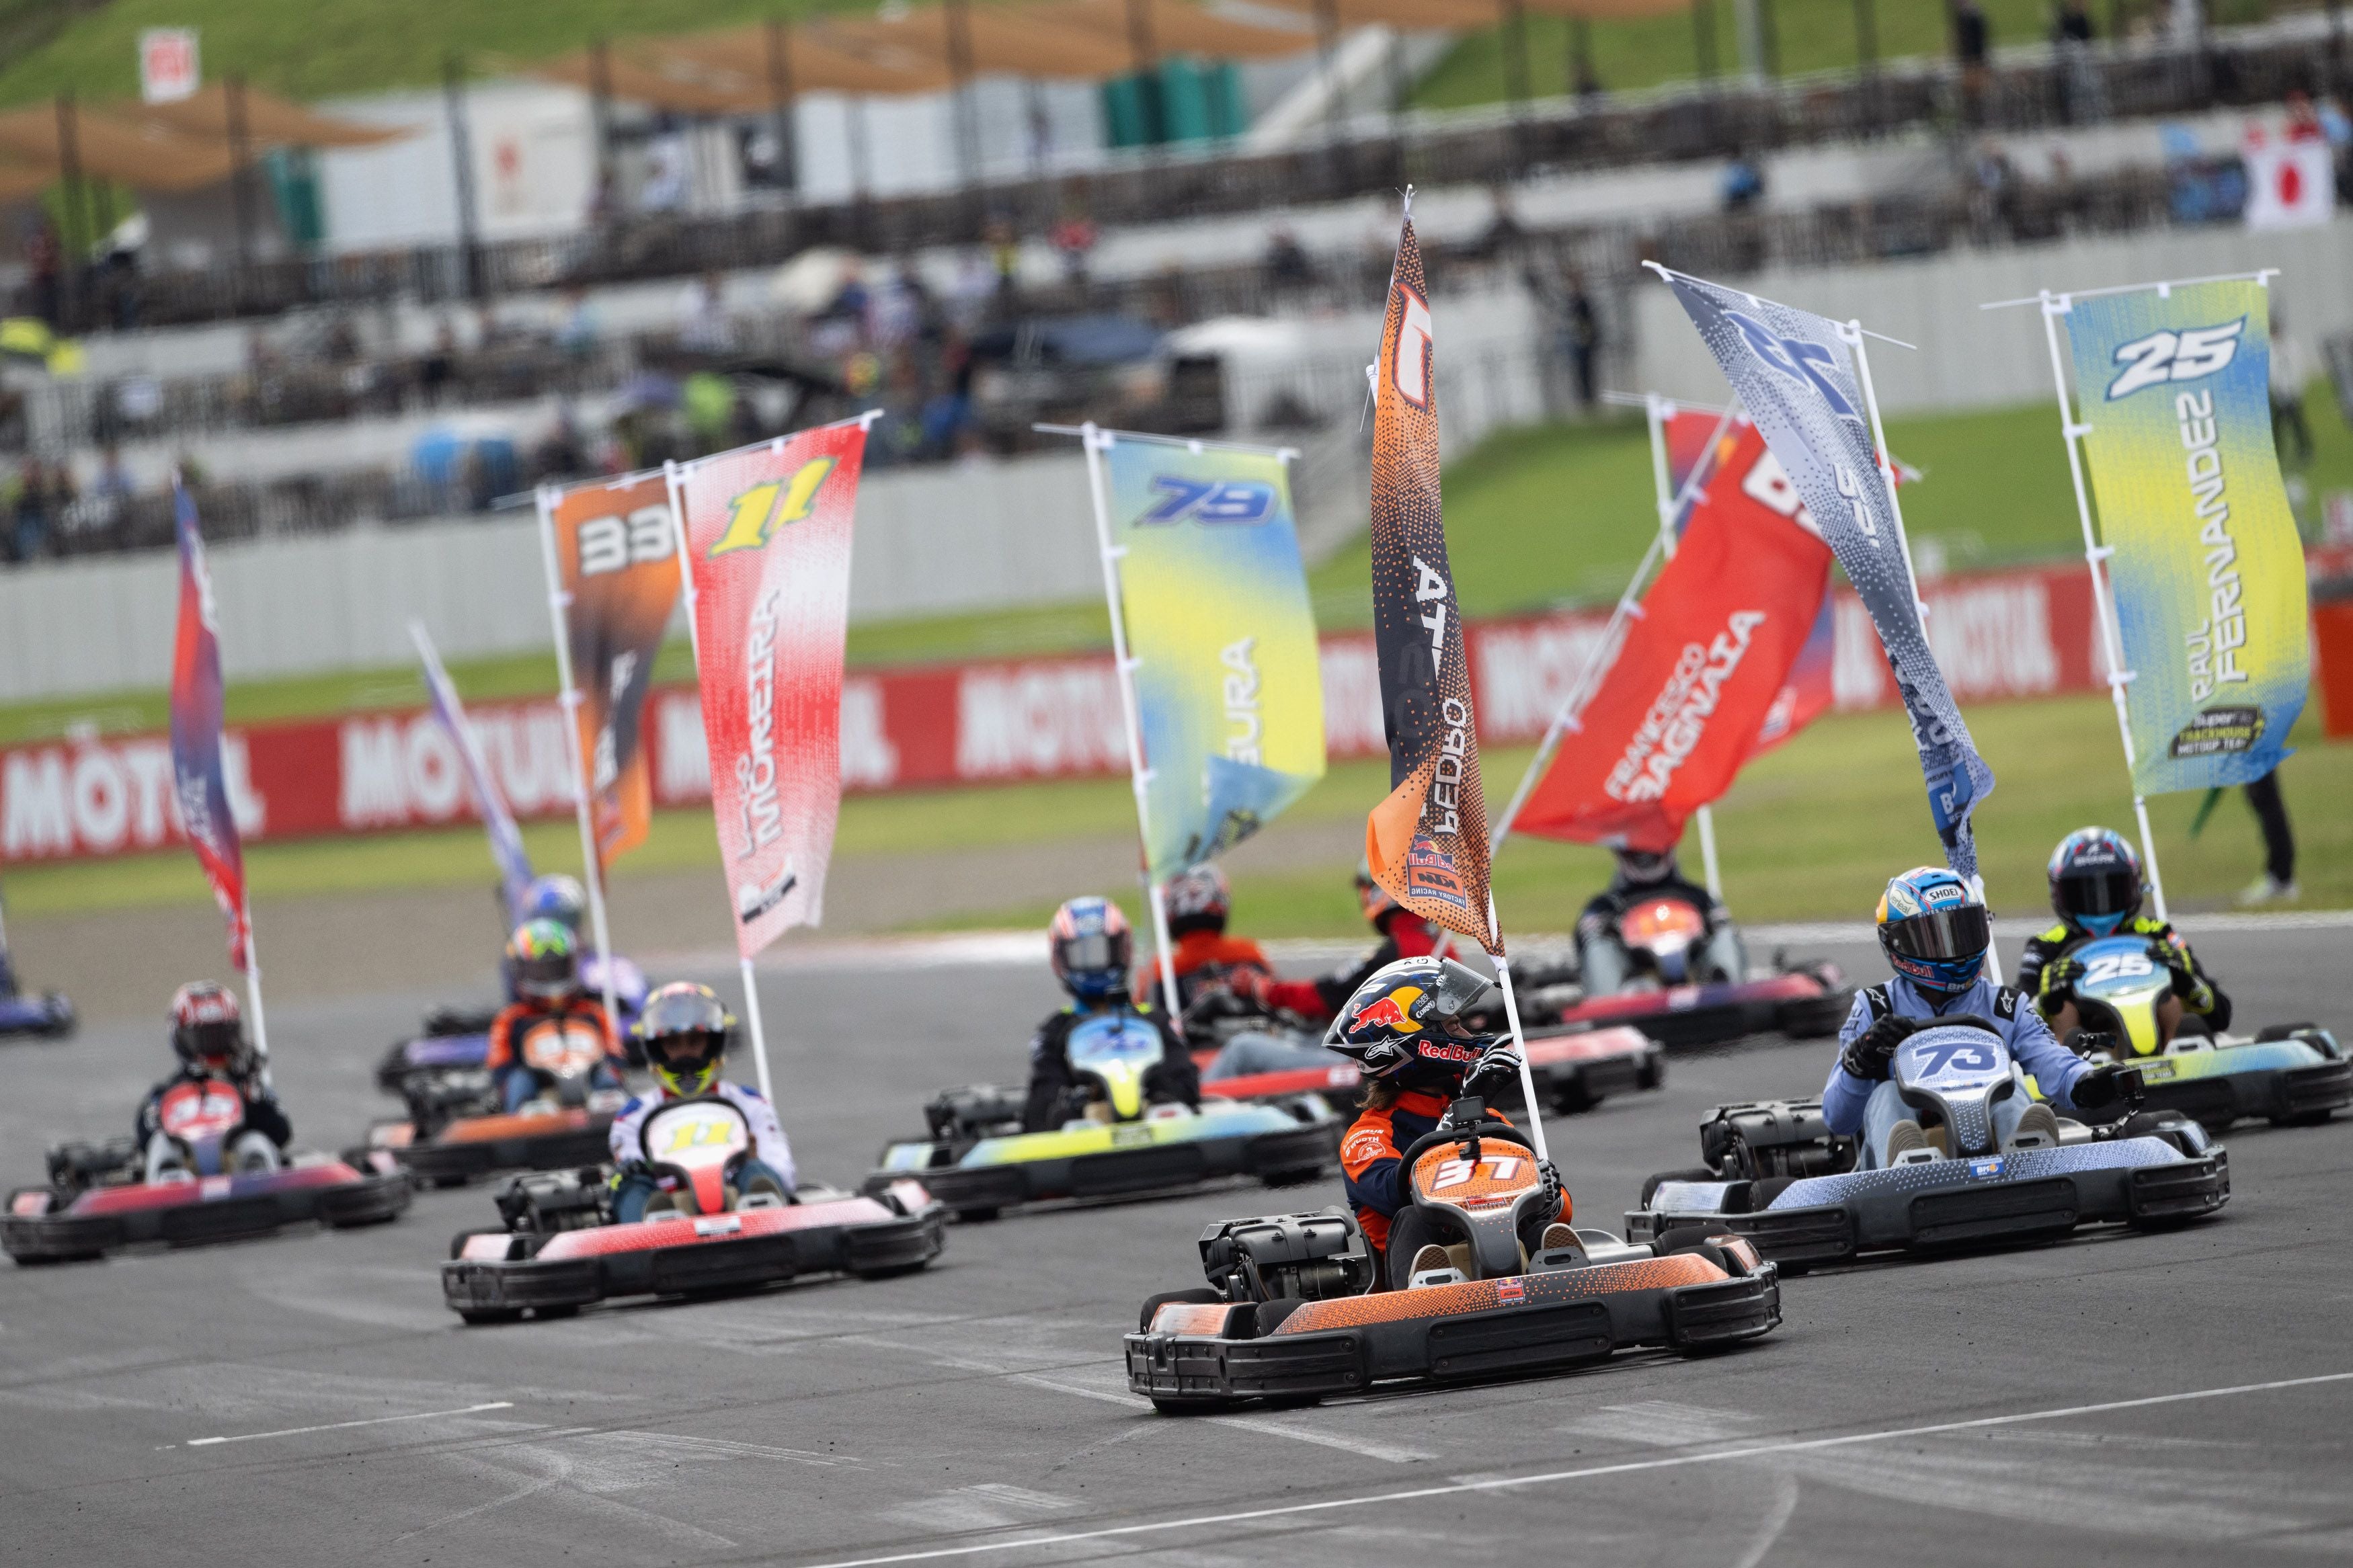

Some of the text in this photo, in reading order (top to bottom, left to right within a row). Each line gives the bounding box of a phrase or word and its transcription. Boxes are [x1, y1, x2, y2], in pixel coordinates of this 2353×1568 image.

[2104, 315, 2247, 402] 25
[707, 457, 839, 561] 11
[1134, 474, 1276, 526] 79
[2177, 388, 2248, 684] FERNANDEZ
[3, 733, 266, 862] MOTL
[1917, 908, 1940, 918] GIVES
[1929, 887, 1958, 901] SHOEI
[2085, 953, 2153, 987] 25
[1419, 1040, 1453, 1060] Red
[1913, 1042, 1997, 1080] 73
[662, 1120, 733, 1155] 11
[1431, 1155, 1529, 1193] 37
